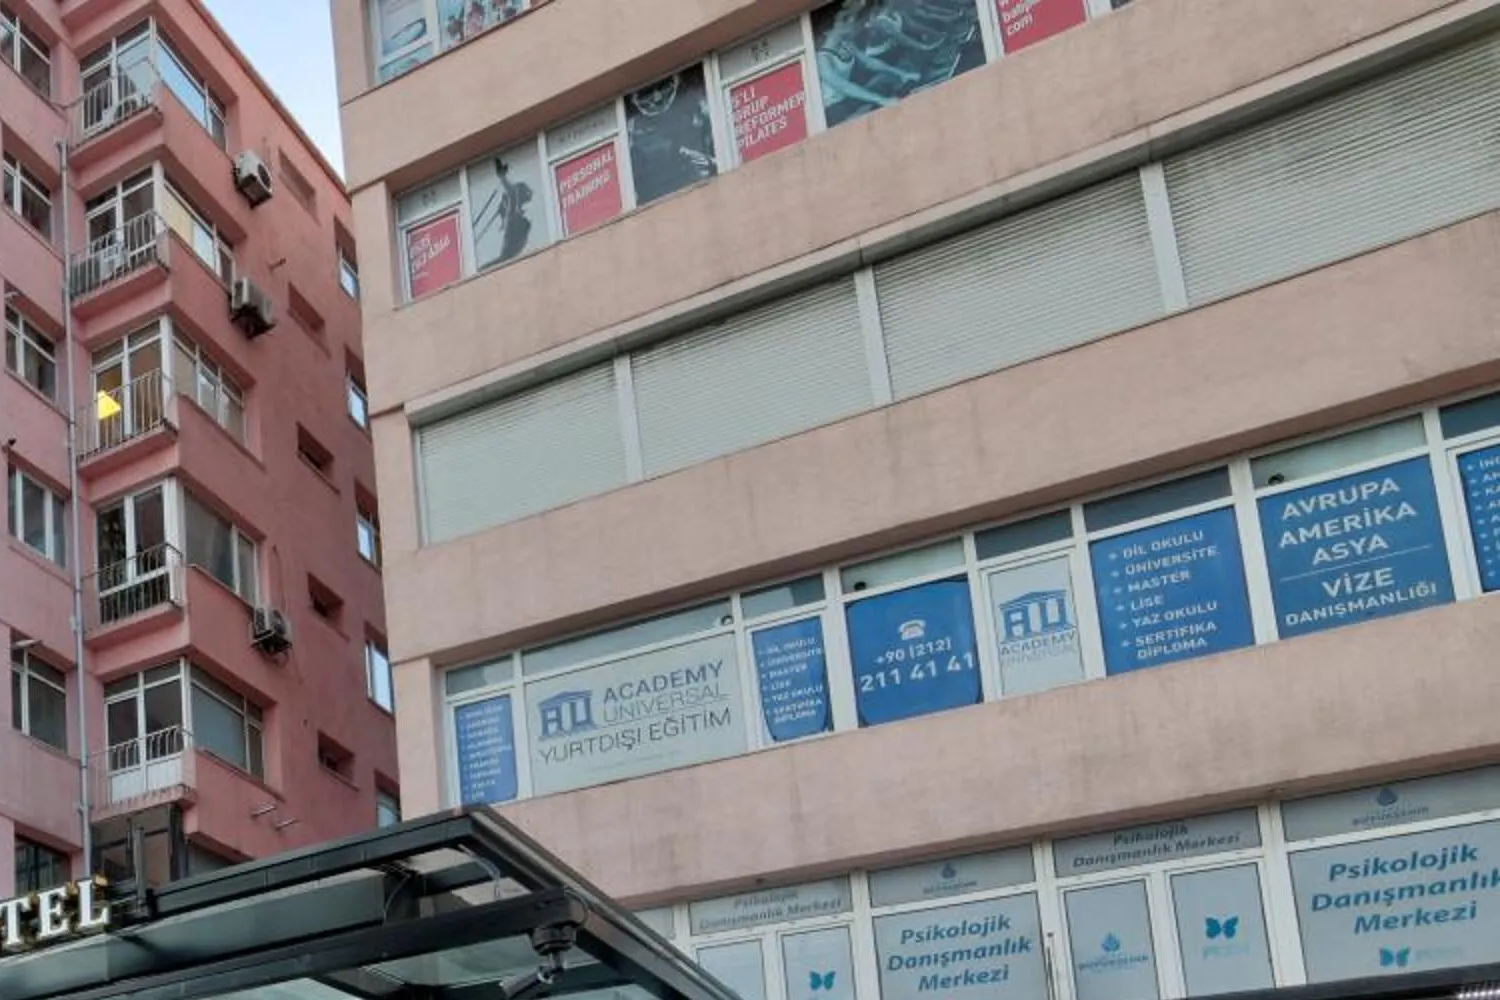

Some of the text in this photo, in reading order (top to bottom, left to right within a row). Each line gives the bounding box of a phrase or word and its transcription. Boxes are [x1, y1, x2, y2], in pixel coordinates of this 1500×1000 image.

[1282, 477, 1400, 520] AVRUPA
[1151, 530, 1204, 552] OKULU
[1279, 501, 1417, 548] AMERİKA
[1312, 533, 1389, 566] ASYA
[1127, 569, 1191, 593] MASTER
[1321, 567, 1396, 598] VİZE
[1131, 599, 1218, 629] YAZ OKULU
[1000, 629, 1076, 656] ACADEMY
[603, 660, 724, 703] ACADEMY
[859, 668, 902, 692] 211
[910, 660, 938, 679] 41
[946, 651, 974, 672] 41
[602, 684, 727, 723] UNIVERSAL
[538, 727, 642, 765] YURTDIŞI
[649, 707, 732, 741] EĞİTİM
[1175, 831, 1241, 852] Merkezi
[1329, 843, 1479, 882] Psikolojik
[1311, 867, 1500, 913] Danışmanlık
[900, 914, 1012, 945] Psikolojik
[1353, 900, 1478, 935] Merkezi
[887, 936, 1033, 971] Danışmanlık
[918, 964, 1010, 992] Merkezi
